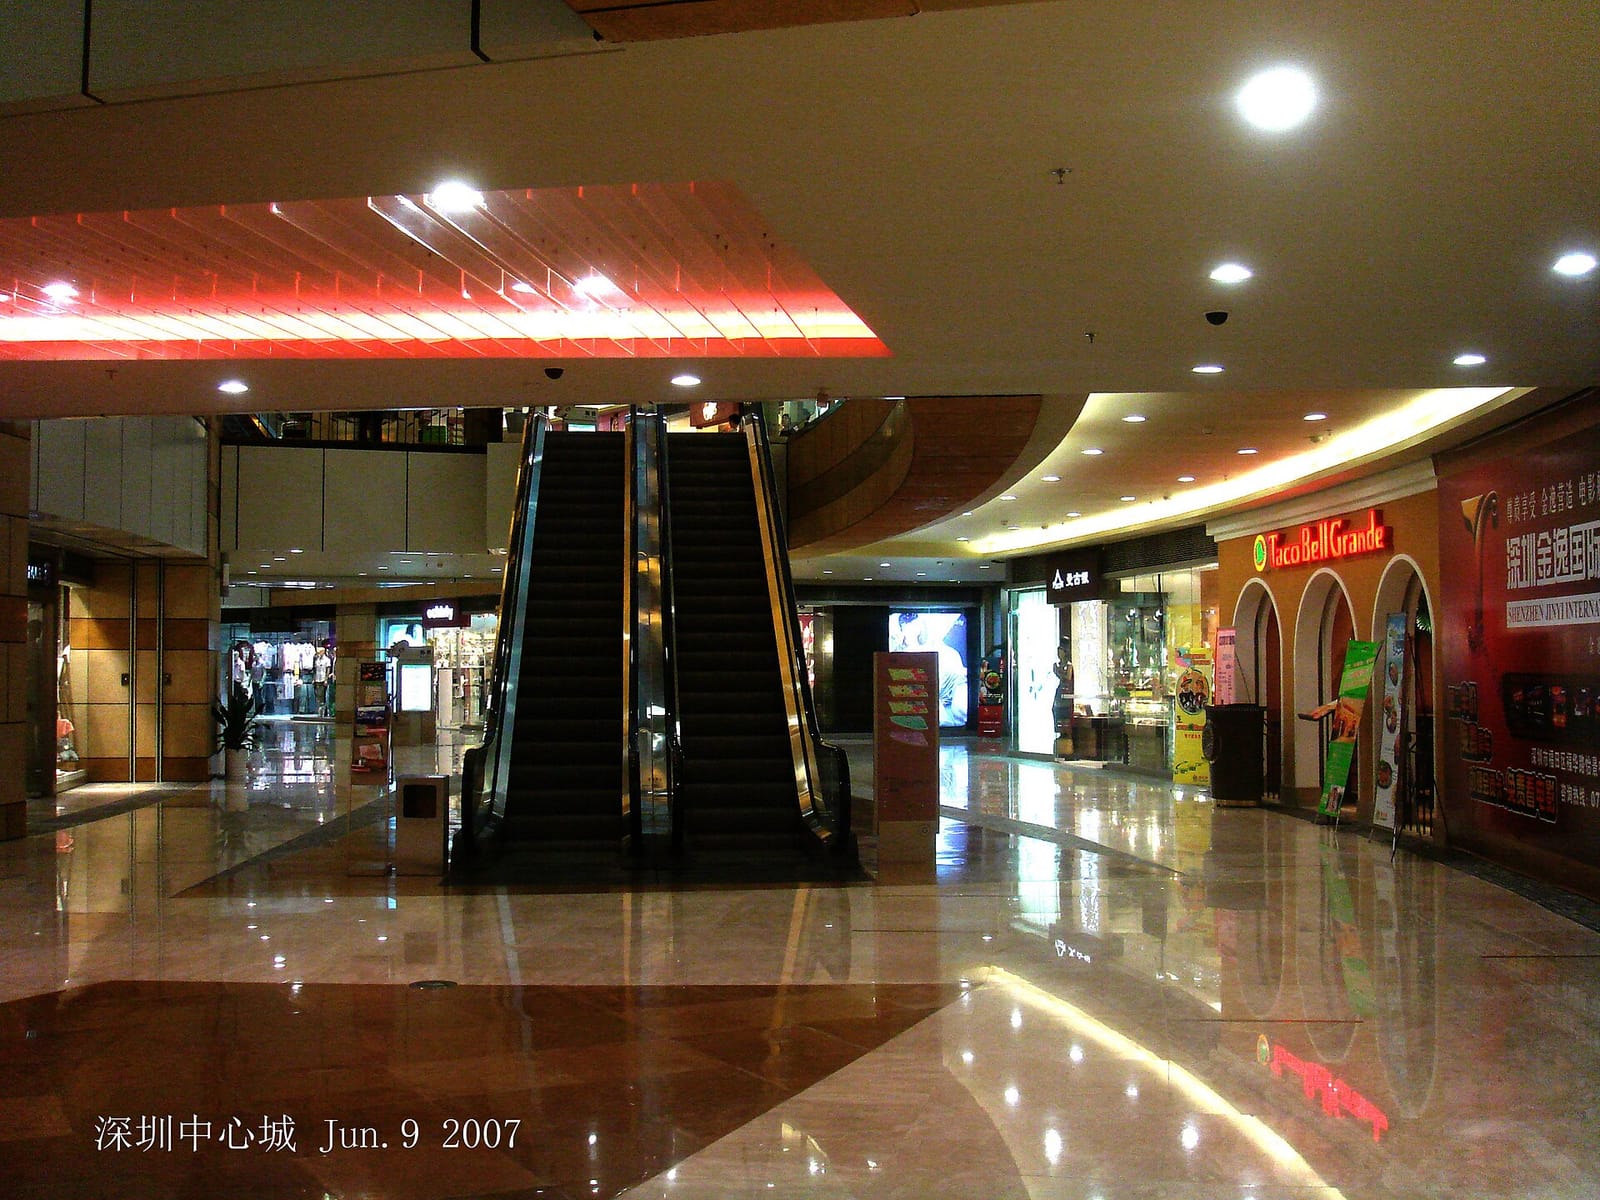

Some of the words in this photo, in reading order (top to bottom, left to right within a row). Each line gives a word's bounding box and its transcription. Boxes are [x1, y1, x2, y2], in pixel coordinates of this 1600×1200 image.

[1267, 532, 1300, 567] Taco
[1301, 521, 1329, 562] Bell
[1328, 508, 1385, 557] Grande
[1507, 604, 1544, 623] SHENZHEN
[1545, 602, 1564, 621] JINYI
[1565, 598, 1600, 619] INTERNA
